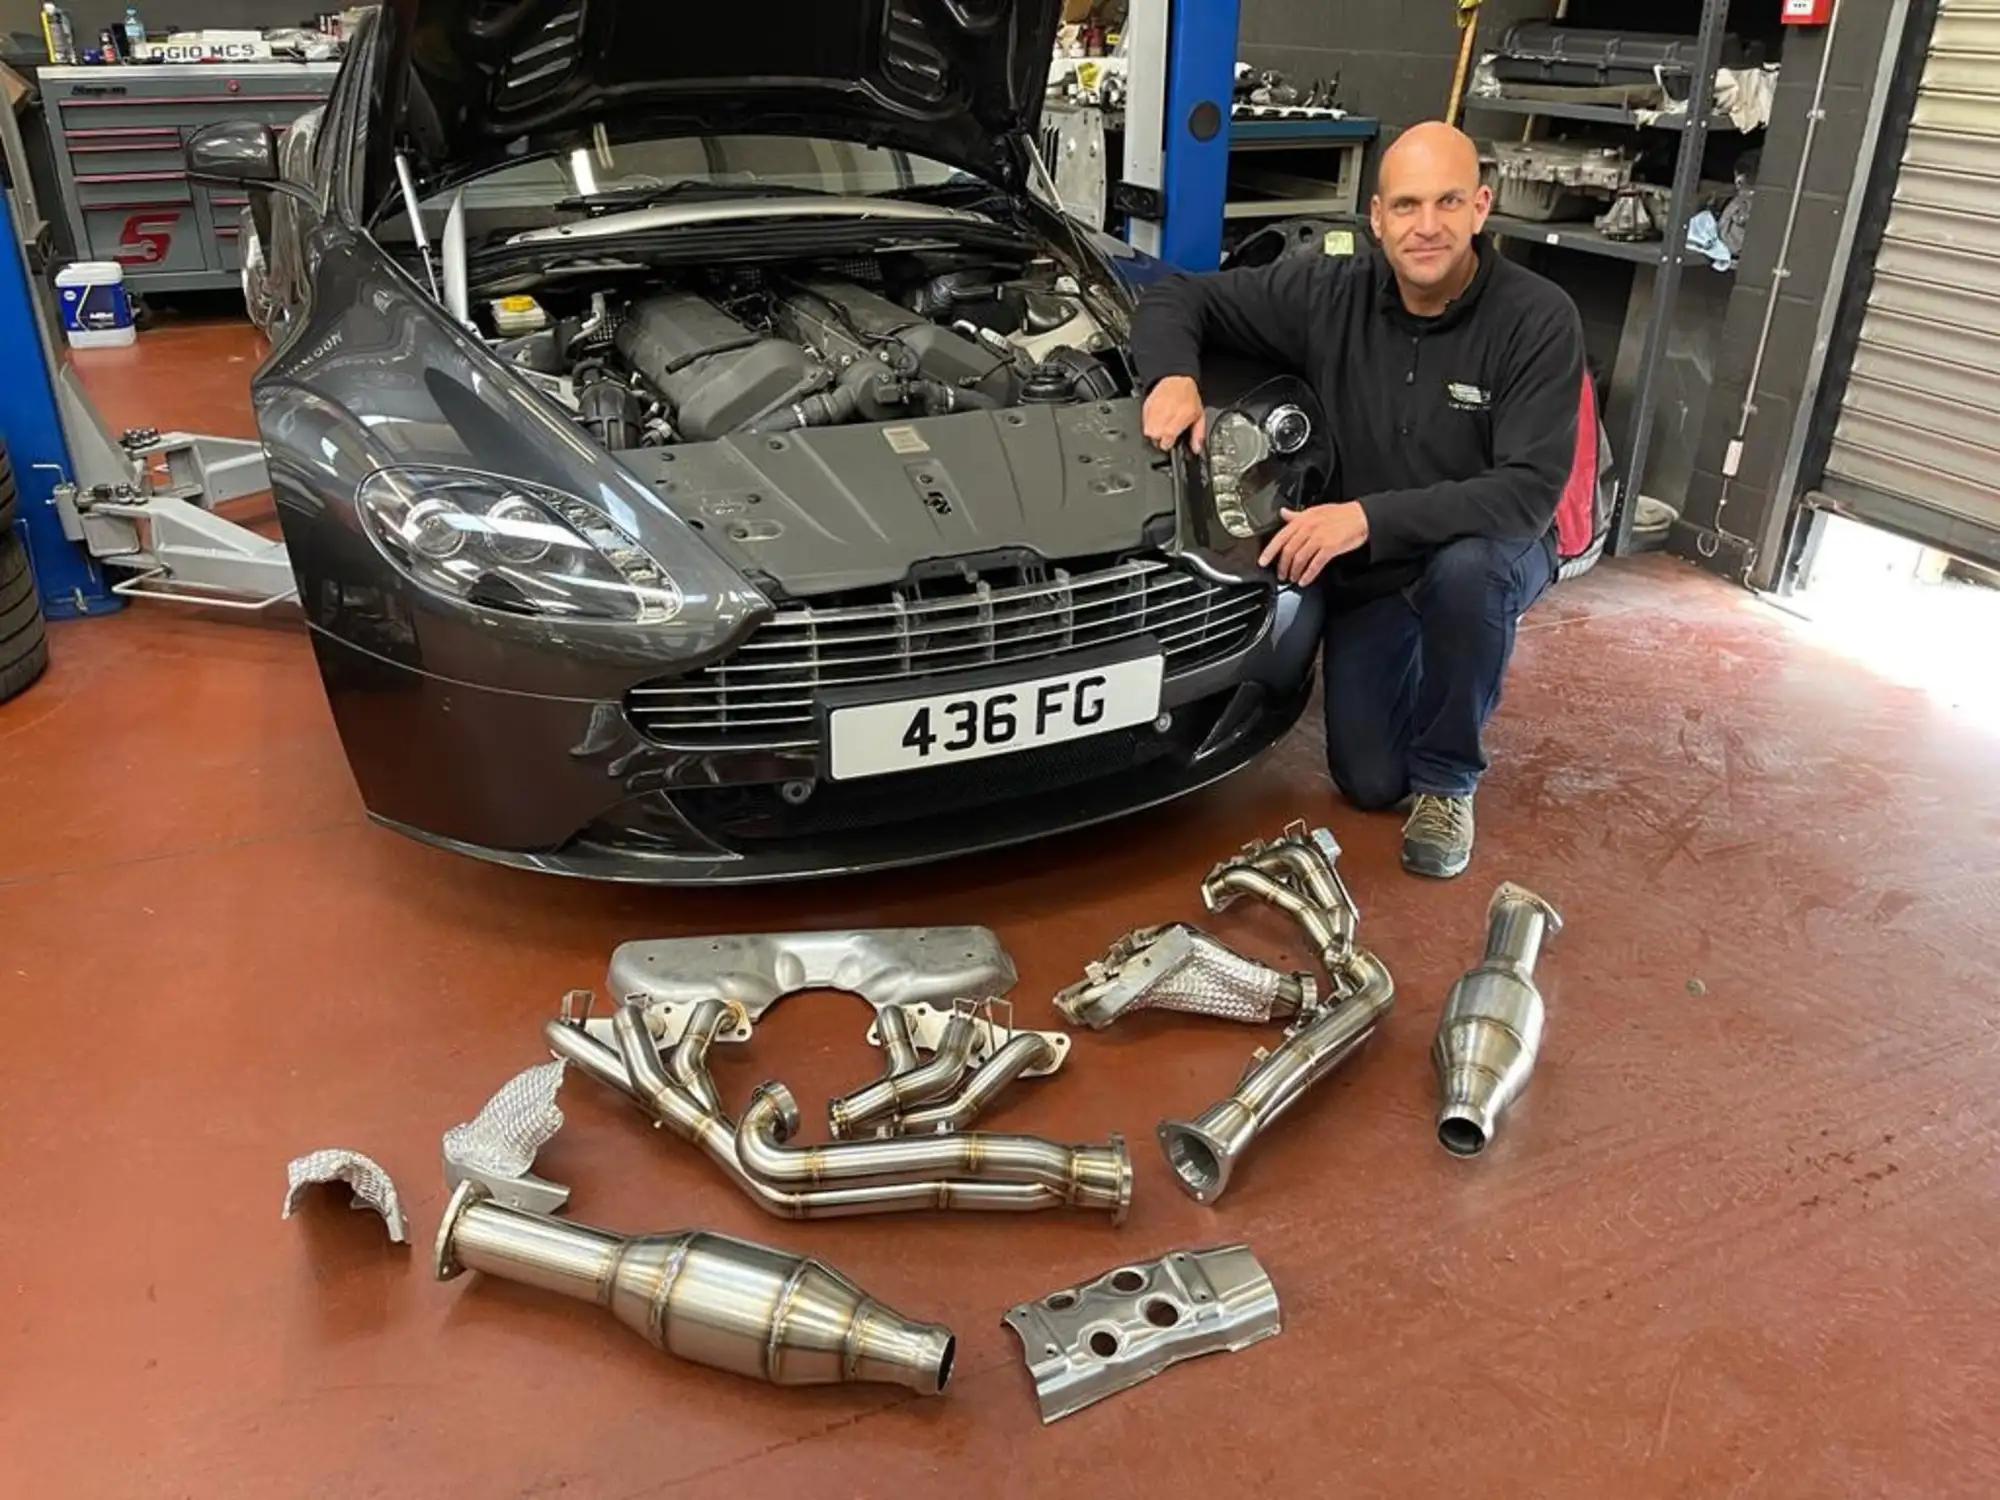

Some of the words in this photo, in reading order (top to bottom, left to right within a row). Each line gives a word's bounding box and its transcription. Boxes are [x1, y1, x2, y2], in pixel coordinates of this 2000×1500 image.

[210, 43, 255, 58] MCS
[902, 693, 1018, 757] 436
[1035, 675, 1106, 735] FG
